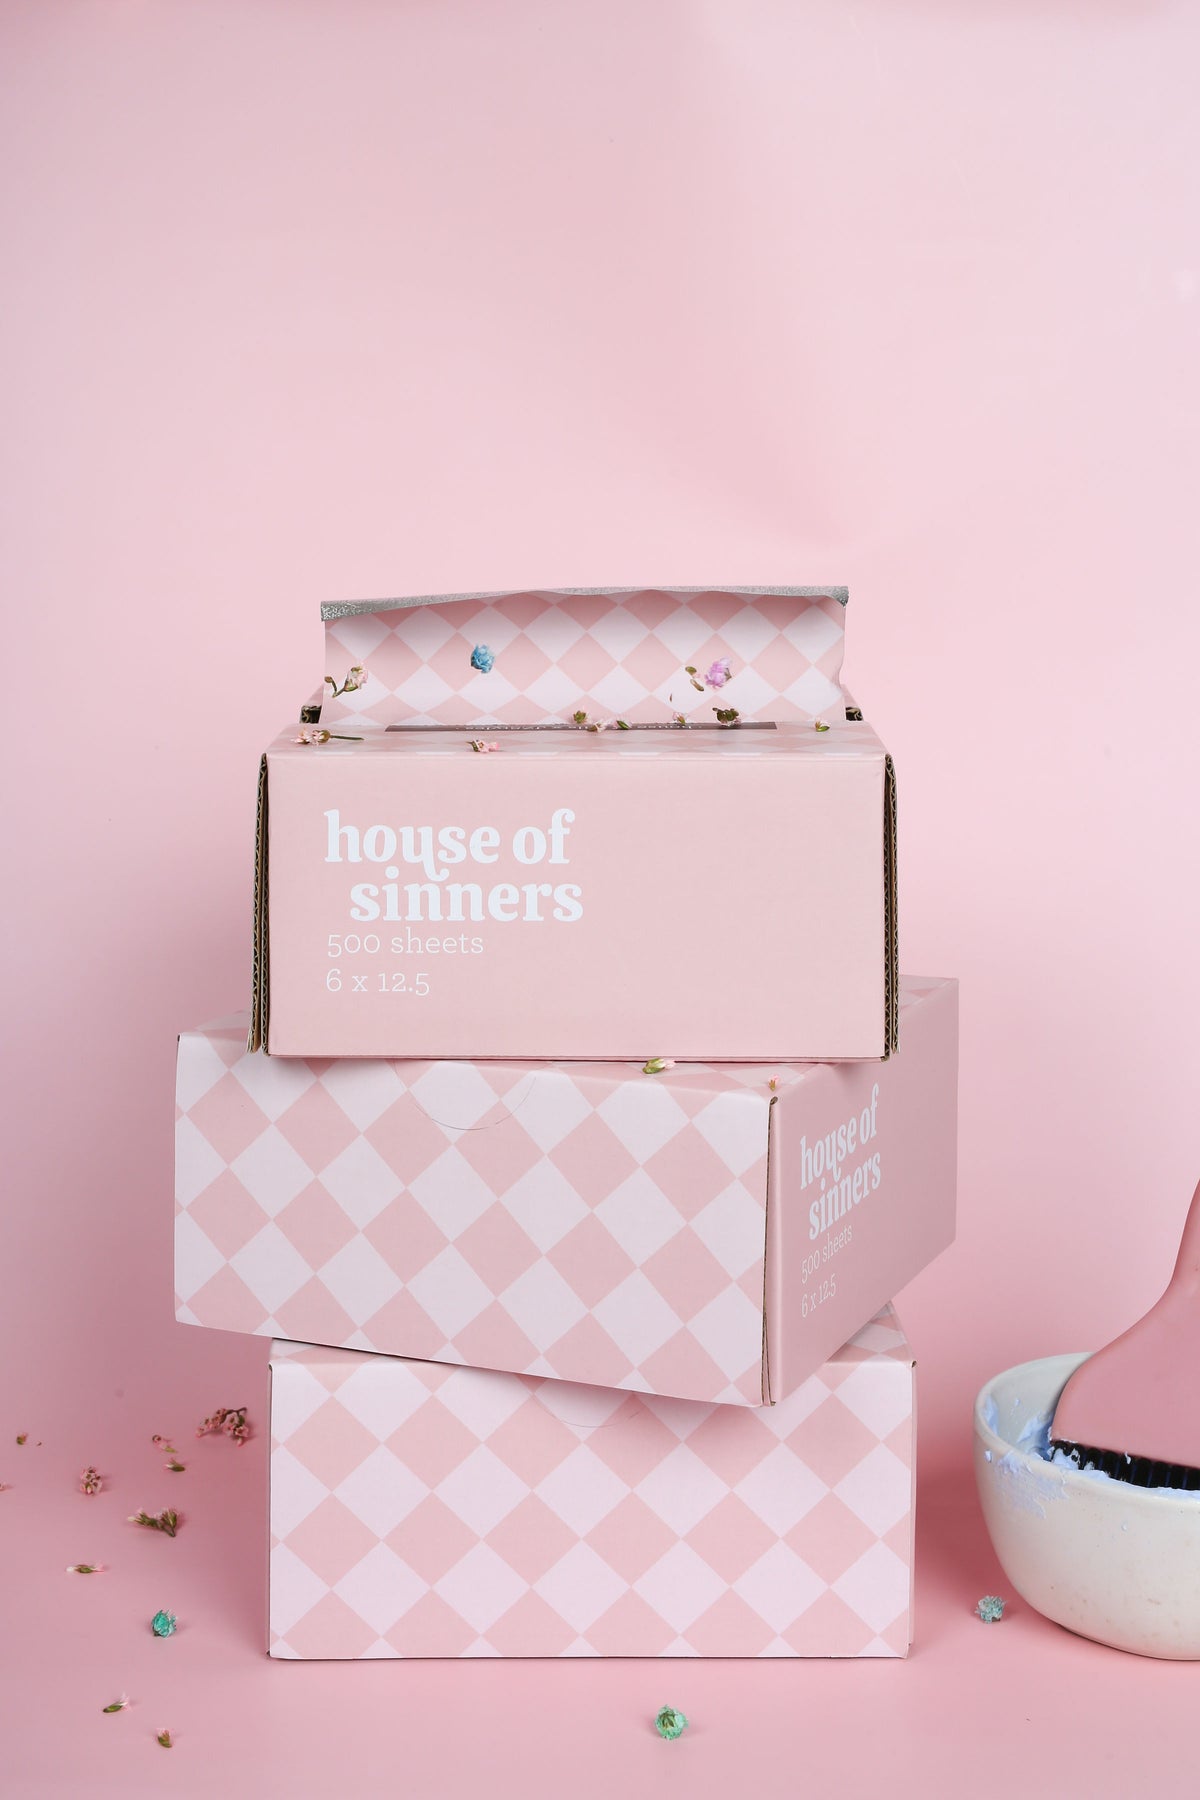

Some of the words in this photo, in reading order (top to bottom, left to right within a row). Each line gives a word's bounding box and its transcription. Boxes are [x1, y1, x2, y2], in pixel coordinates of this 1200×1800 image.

[323, 808, 501, 881] house
[512, 807, 576, 865] of
[349, 866, 584, 922] sinners
[326, 933, 381, 958] 500
[390, 926, 484, 954] sheets
[326, 967, 343, 993] 6
[351, 975, 369, 993] x
[377, 972, 431, 997] 12.5
[800, 1116, 858, 1191] house
[859, 1082, 880, 1145] of
[808, 1151, 882, 1241] sinners
[801, 1249, 821, 1285] 500
[822, 1223, 853, 1264] sheets
[801, 1293, 809, 1319] 6
[810, 1290, 817, 1313] x
[818, 1272, 837, 1307] 12.5
